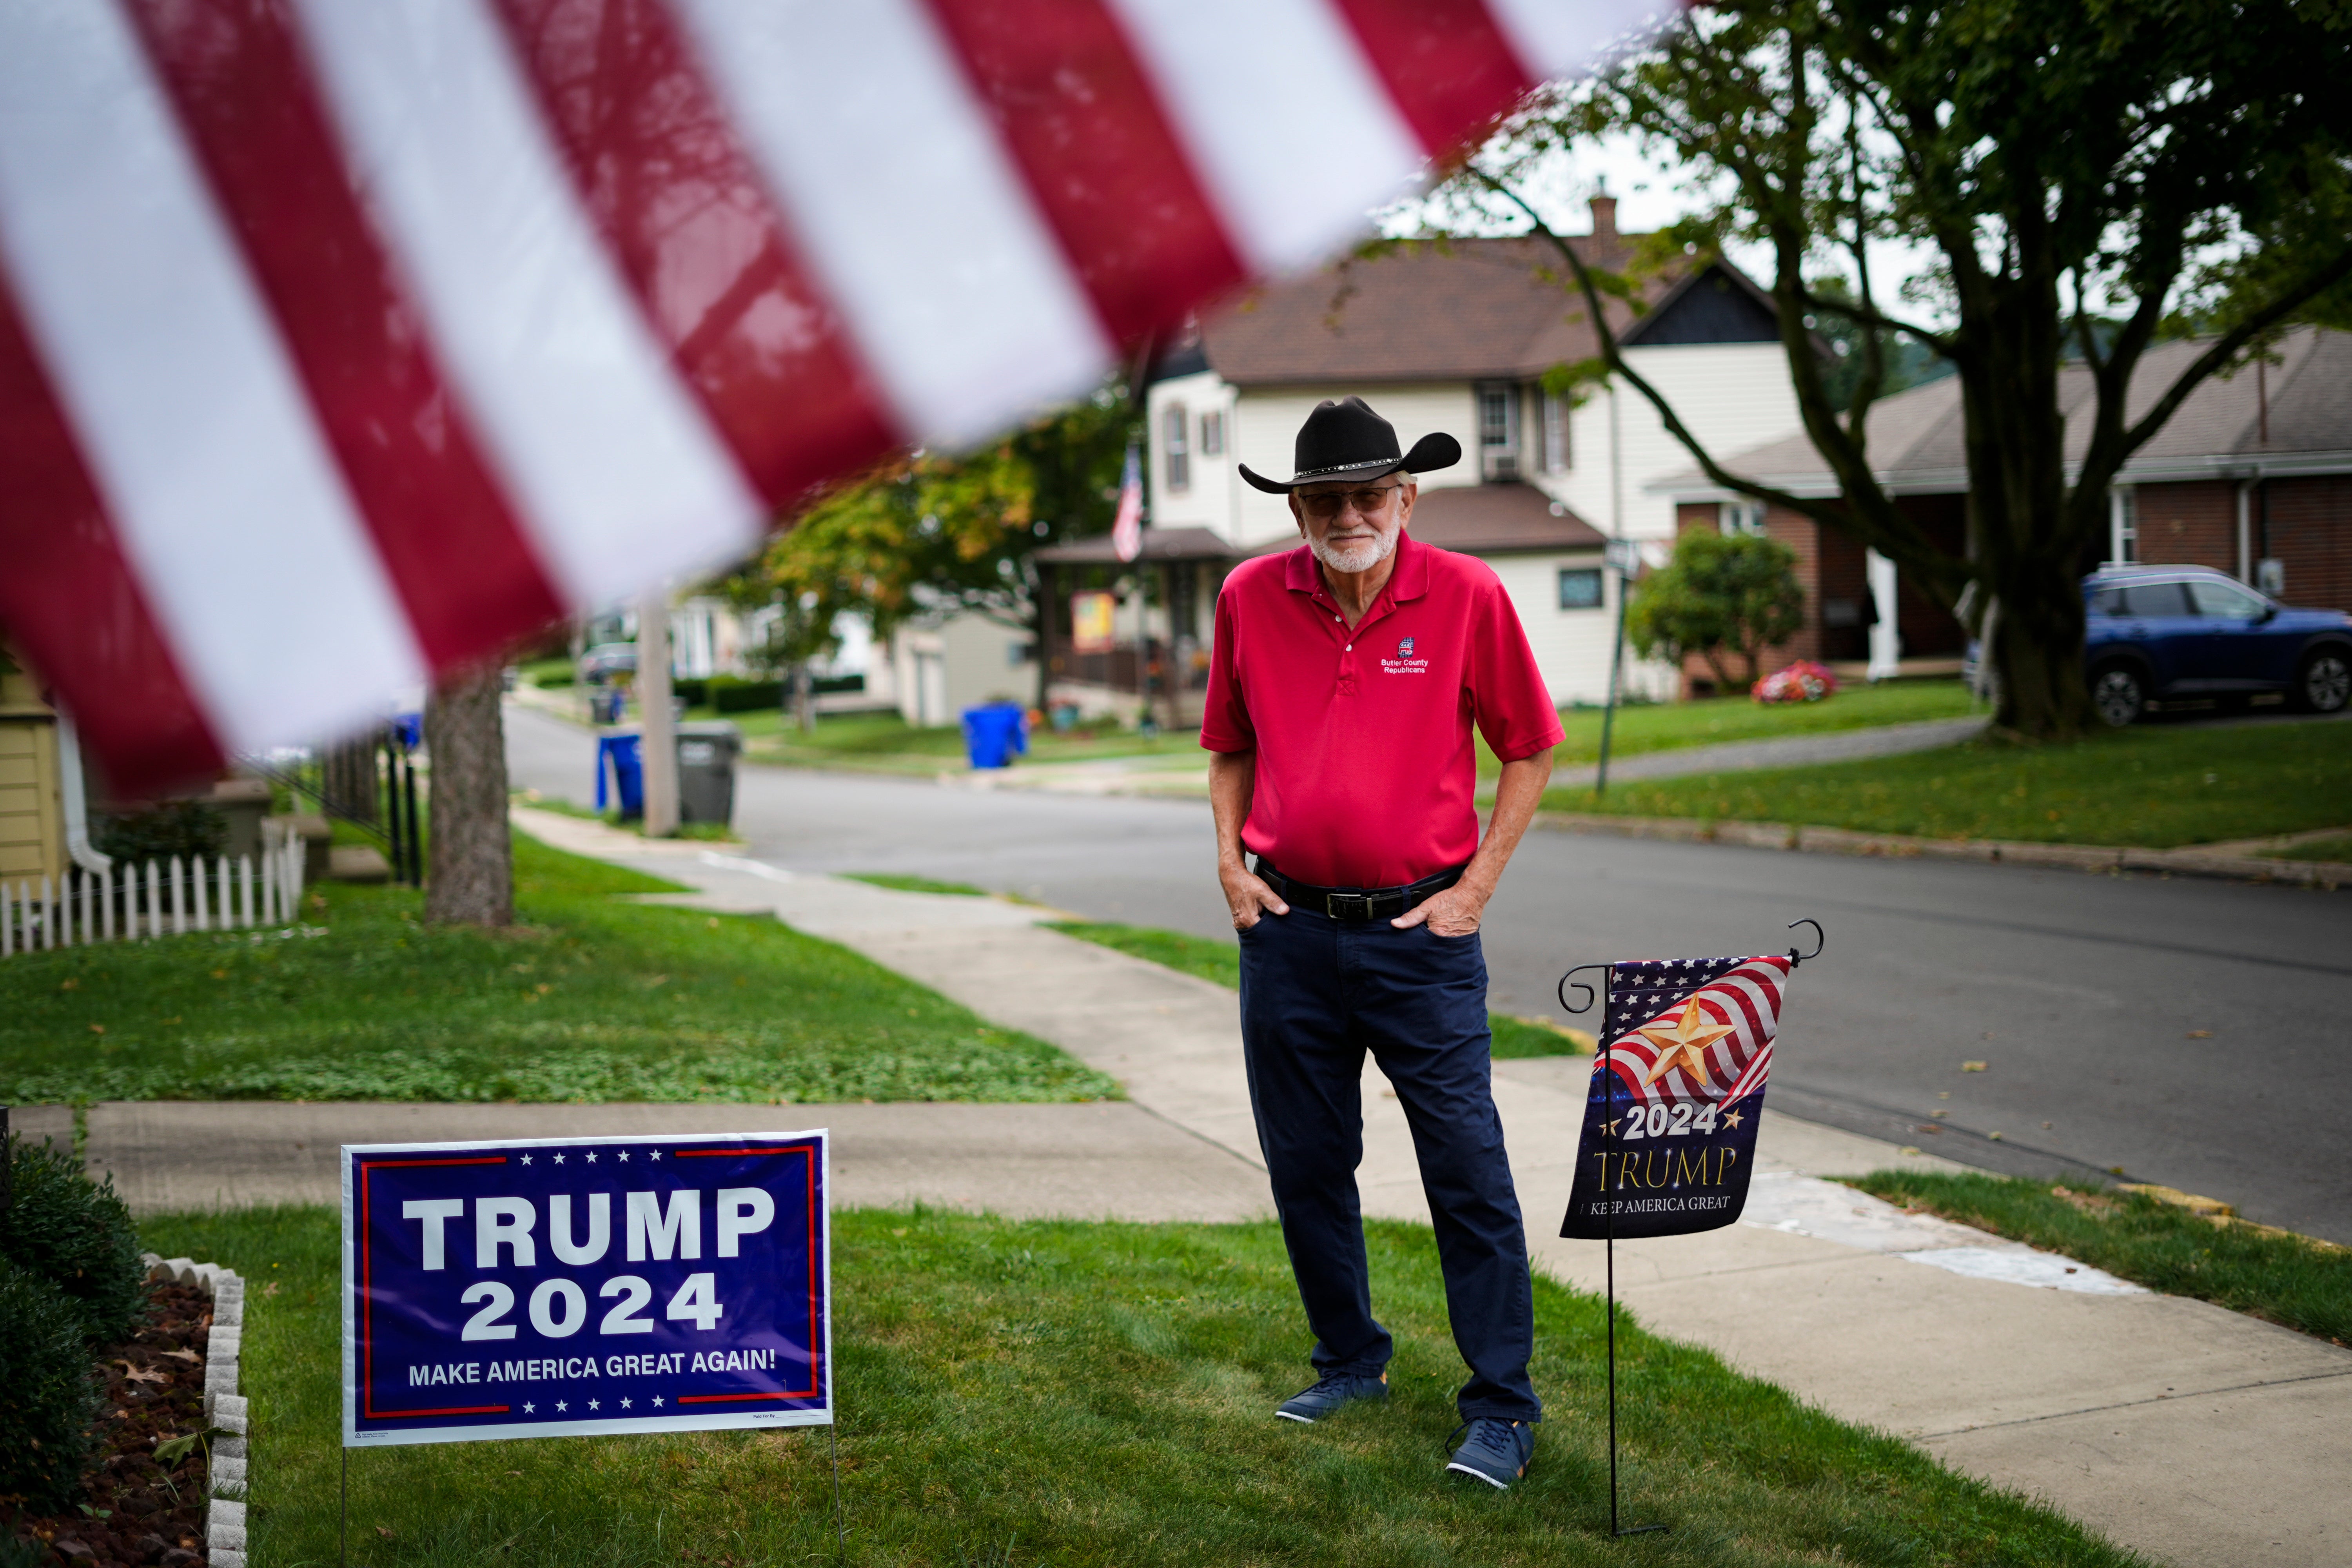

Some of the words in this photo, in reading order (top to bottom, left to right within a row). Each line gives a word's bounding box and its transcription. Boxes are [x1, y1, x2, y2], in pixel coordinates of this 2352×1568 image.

[1623, 1102, 1717, 1140] 2024
[1593, 1145, 1736, 1191] TRUMP
[1624, 1198, 1685, 1213] AMERICA
[1688, 1196, 1731, 1210] GREAT
[402, 1187, 775, 1270] TRUMP
[461, 1272, 723, 1341] 2024
[409, 1363, 480, 1386] MAKE
[486, 1357, 599, 1382] AMERICA
[606, 1353, 685, 1376] GREAT
[691, 1349, 775, 1372] AGAIN!
